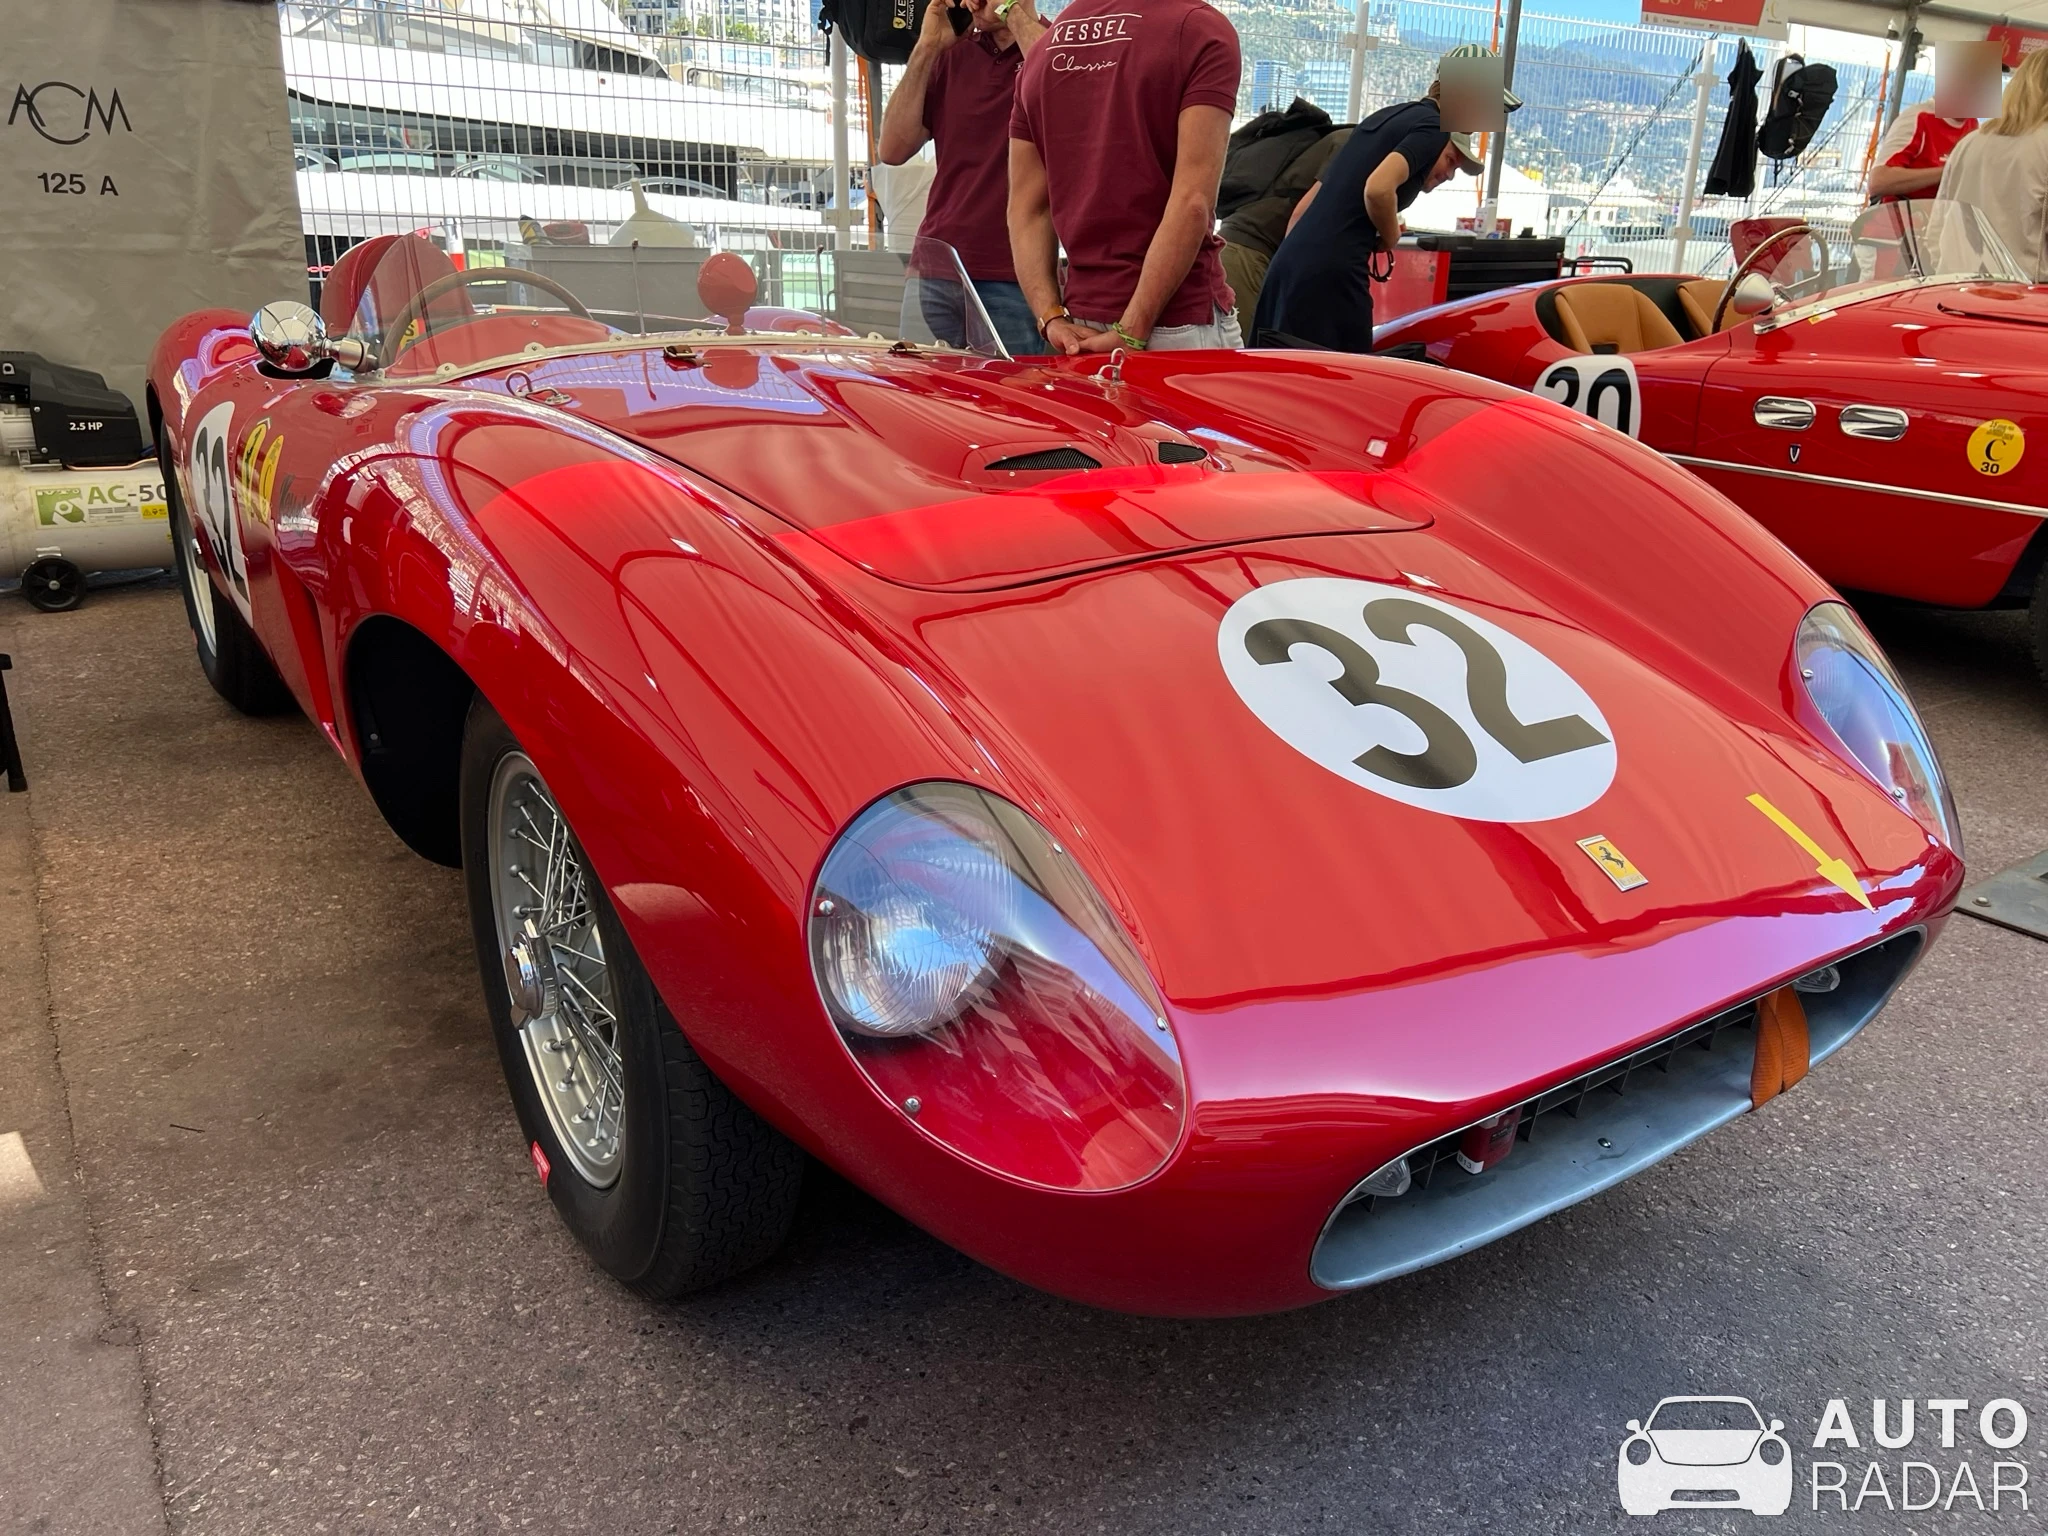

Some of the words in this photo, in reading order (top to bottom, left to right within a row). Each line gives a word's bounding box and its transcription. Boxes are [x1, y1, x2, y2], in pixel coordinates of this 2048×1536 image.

[1051, 19, 1126, 43] KESSEL
[1051, 53, 1117, 71] Classic
[8, 81, 132, 145] ACM
[37, 172, 86, 195] 125
[100, 175, 119, 196] A
[69, 422, 86, 431] 2.5
[88, 422, 103, 431] HP
[1985, 438, 2007, 461] C
[1980, 461, 2000, 474] 30
[1244, 598, 1611, 789] 32
